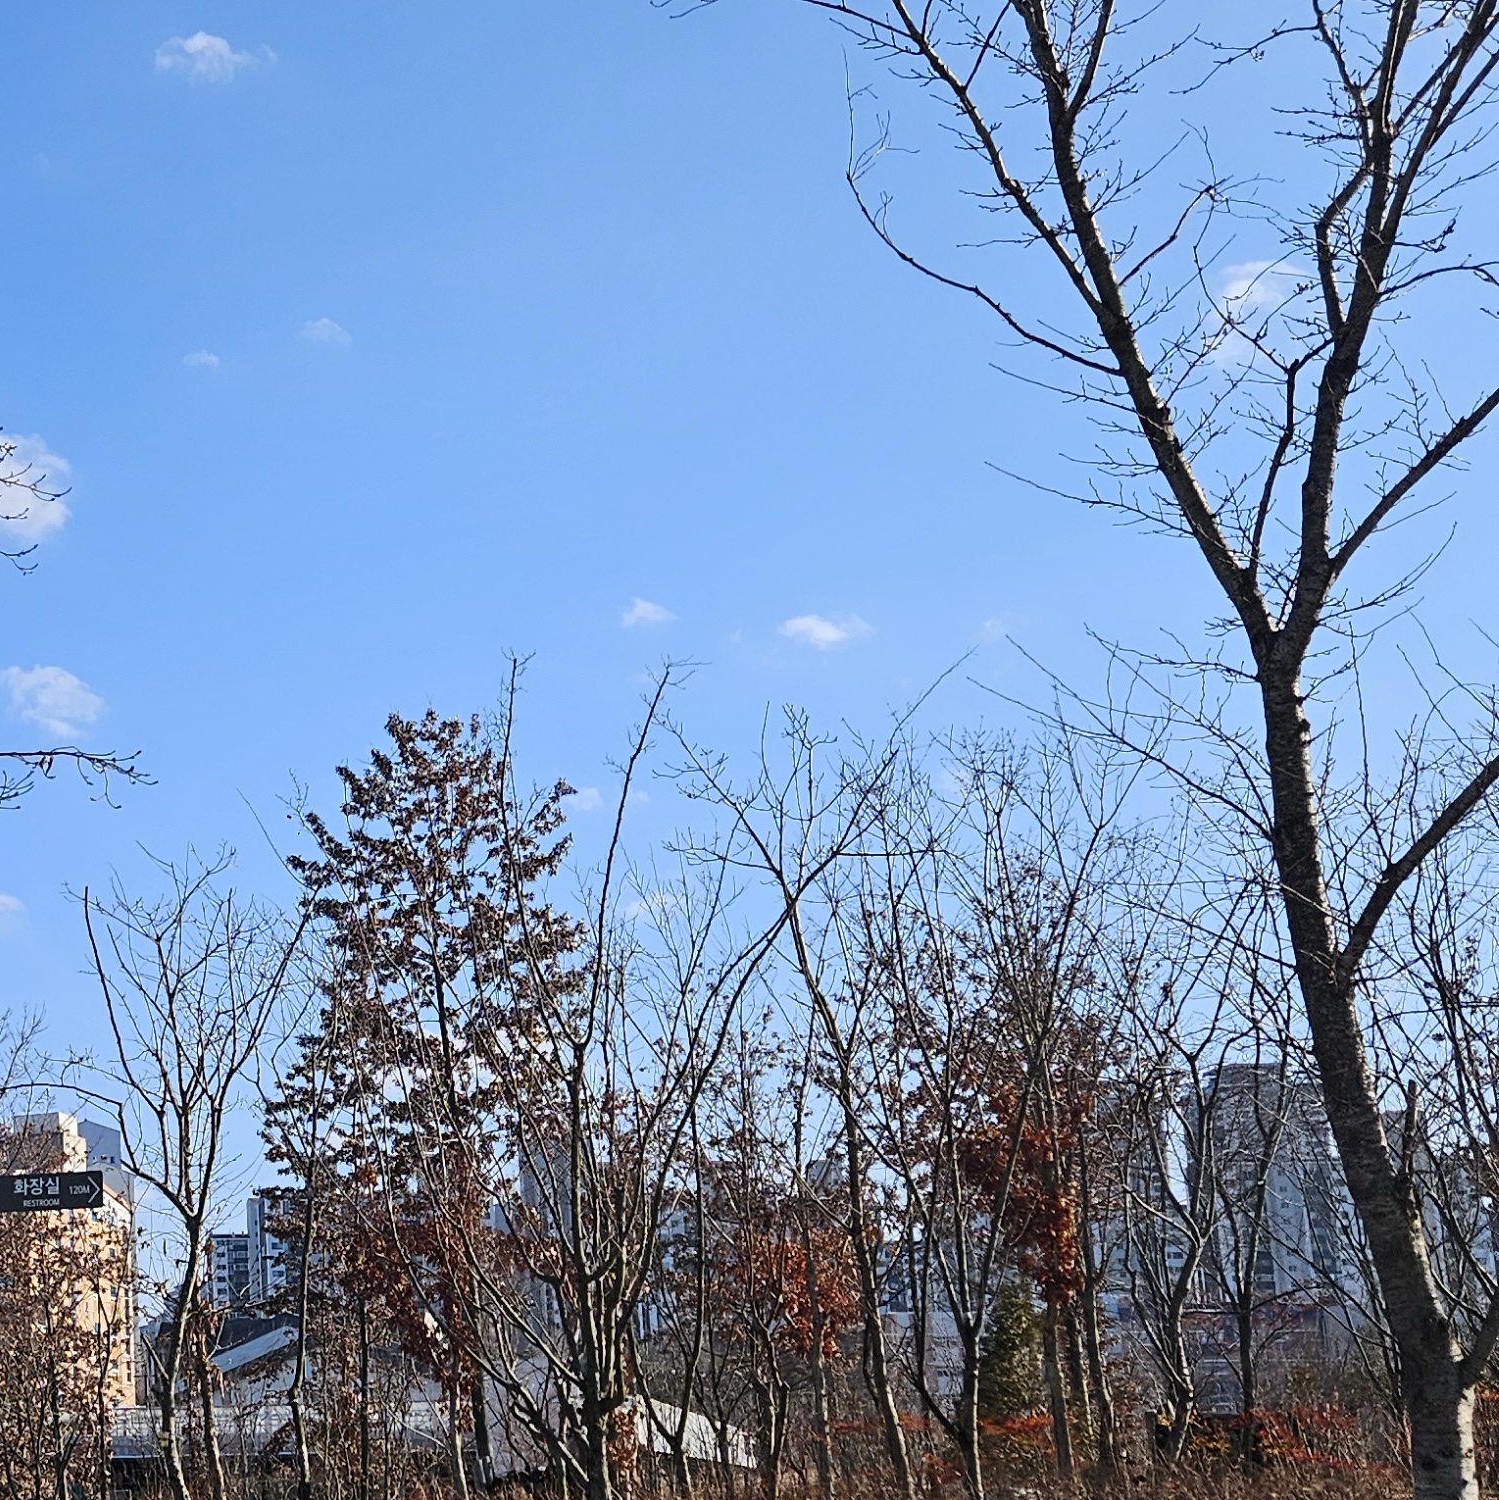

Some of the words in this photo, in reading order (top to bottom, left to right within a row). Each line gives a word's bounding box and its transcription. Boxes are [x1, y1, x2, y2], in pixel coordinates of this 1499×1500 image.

[13, 1176, 60, 1196] 화장실
[68, 1185, 90, 1195] 120M
[23, 1198, 60, 1208] RESTROOM
